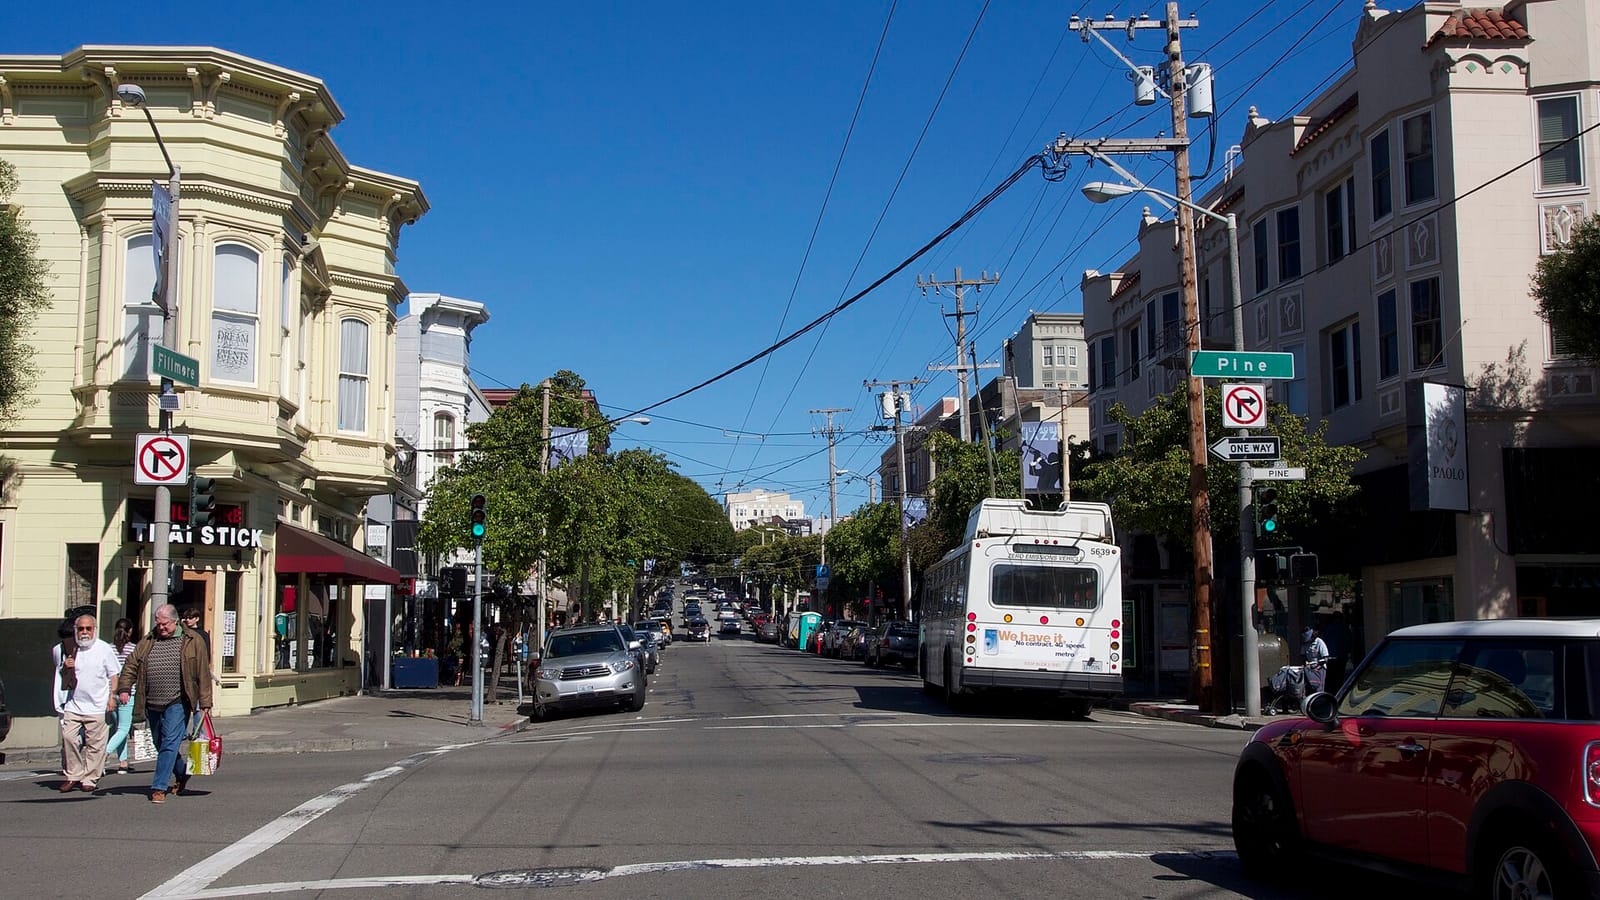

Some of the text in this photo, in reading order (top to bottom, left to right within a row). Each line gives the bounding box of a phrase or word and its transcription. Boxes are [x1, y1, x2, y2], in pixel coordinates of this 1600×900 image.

[217, 330, 249, 343] DREAM
[217, 349, 249, 362] EVENTS
[158, 352, 195, 379] Fillmore
[1218, 358, 1268, 372] Pine
[1230, 443, 1272, 454] ONE WAY
[1433, 466, 1465, 480] PAOLO
[200, 525, 263, 547] STICK
[1090, 547, 1111, 557] 5639
[998, 630, 1018, 641] We
[1020, 631, 1051, 642] have
